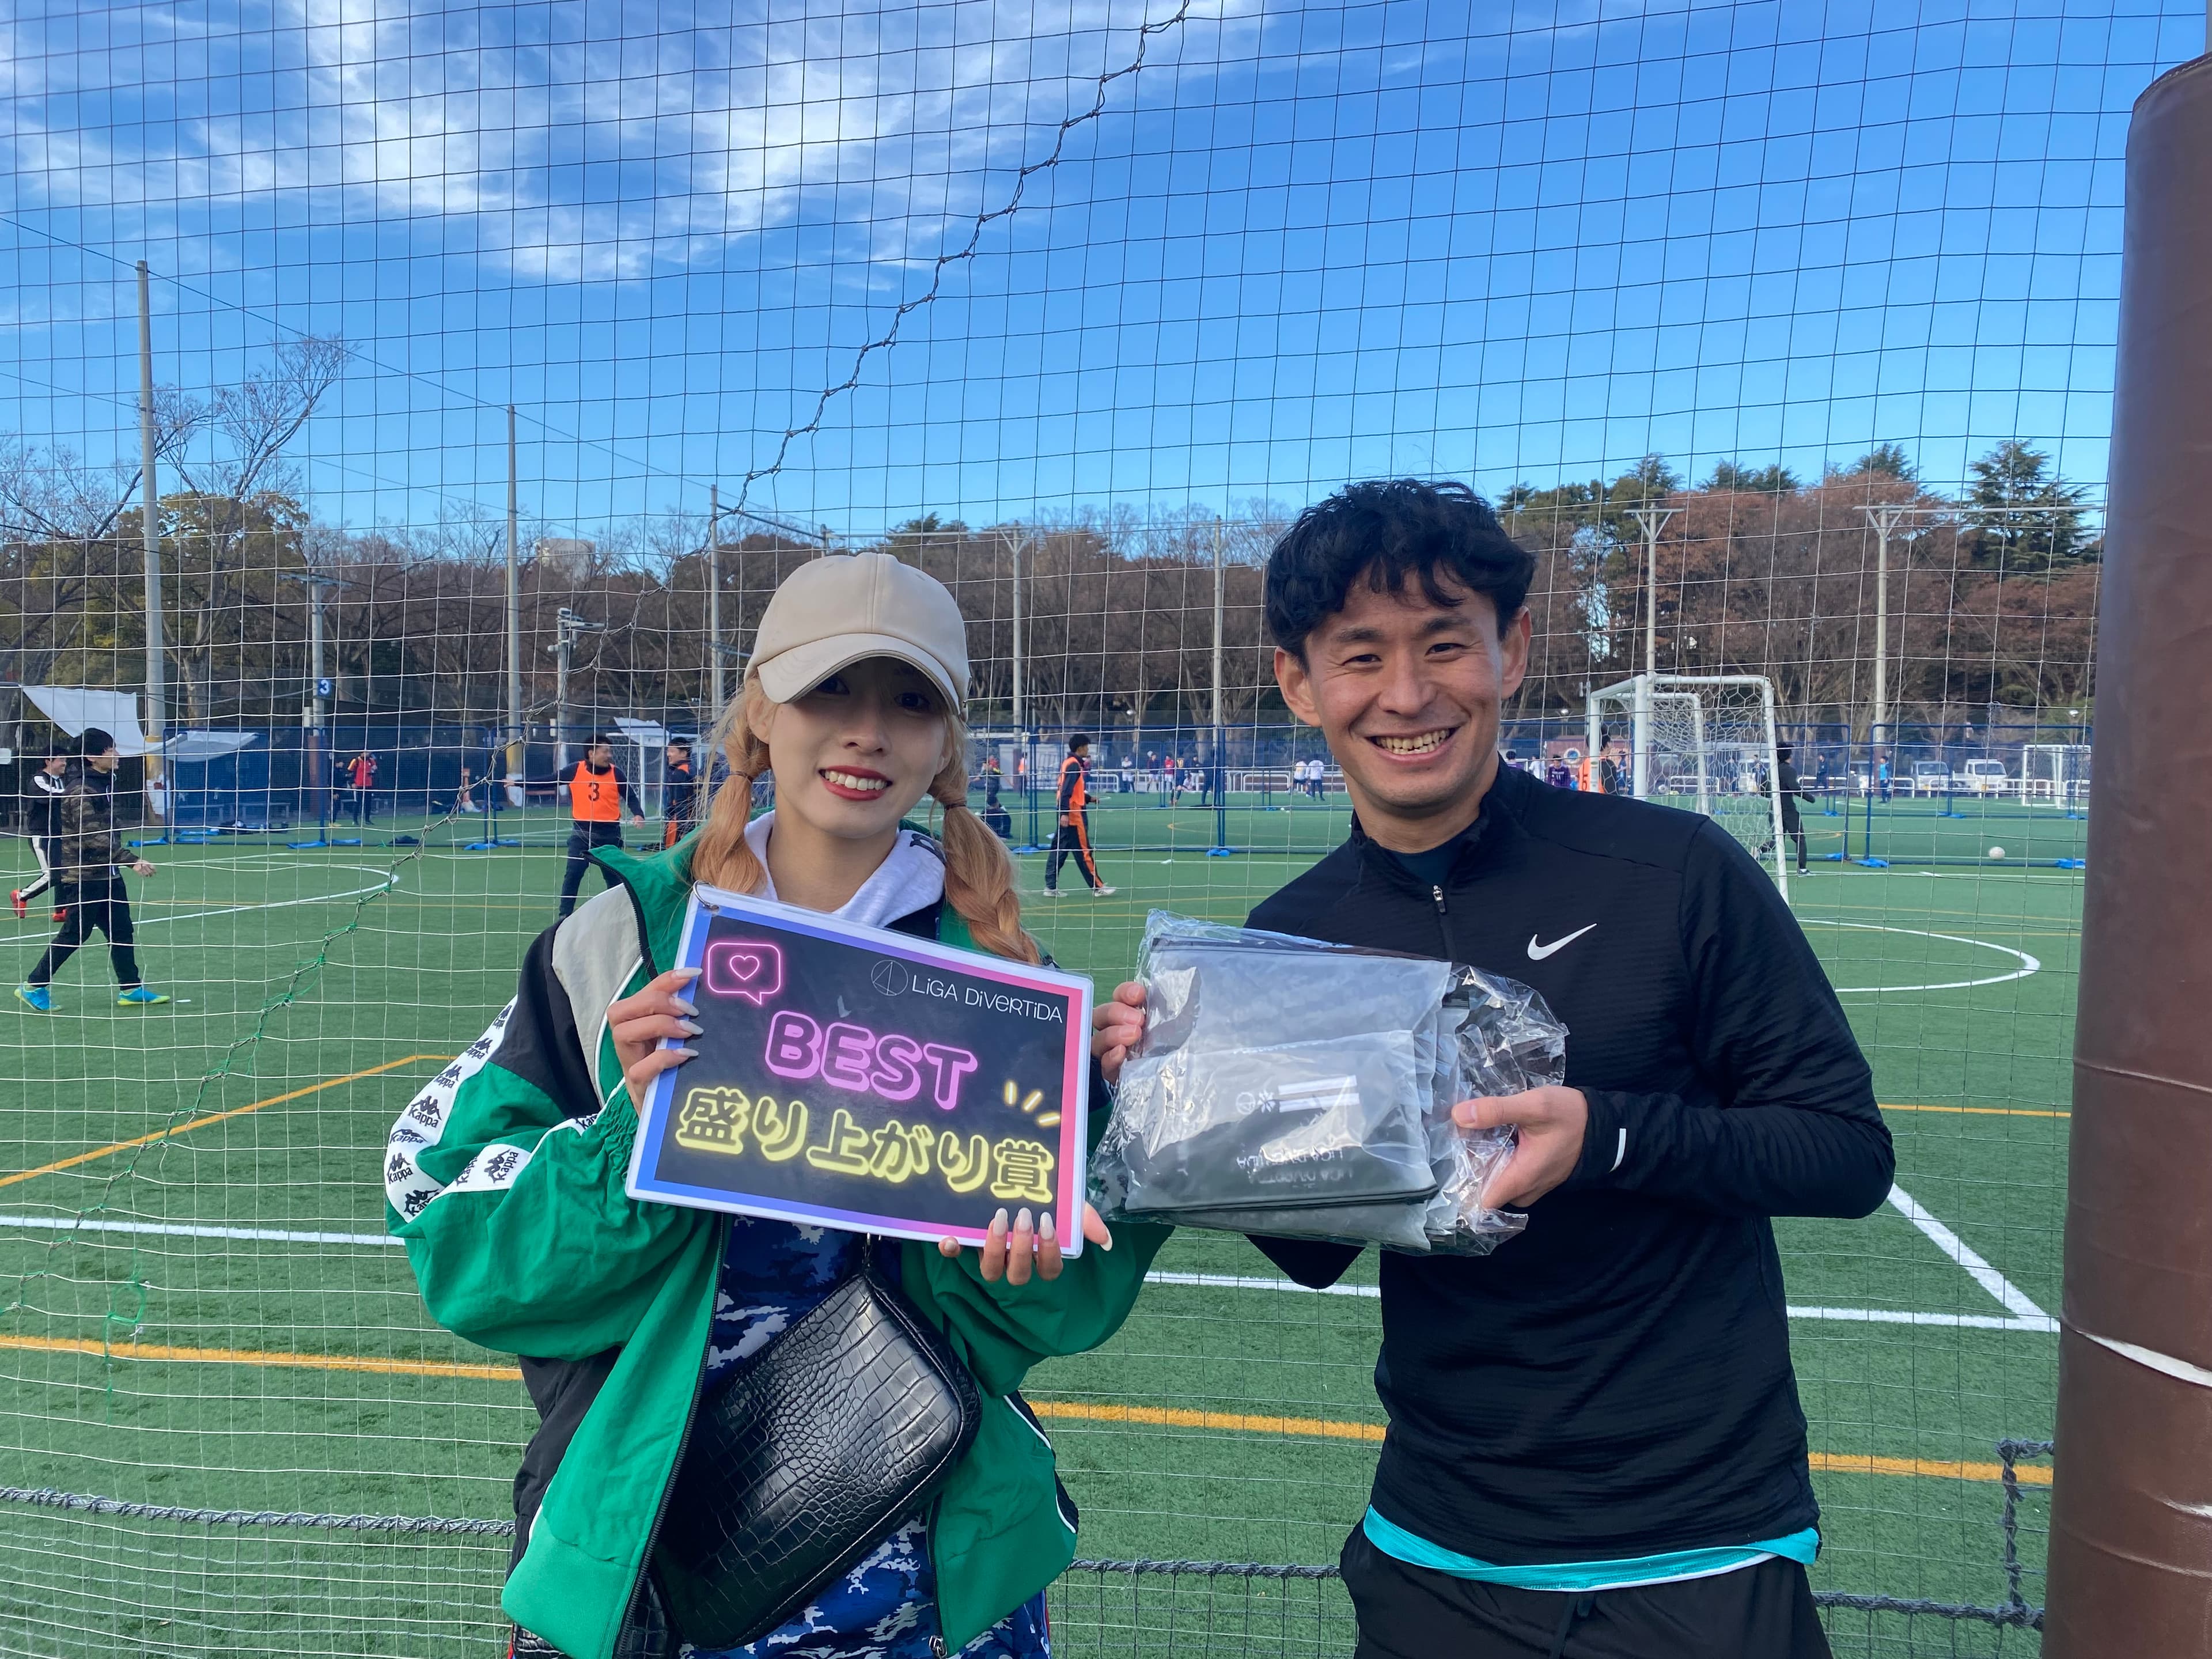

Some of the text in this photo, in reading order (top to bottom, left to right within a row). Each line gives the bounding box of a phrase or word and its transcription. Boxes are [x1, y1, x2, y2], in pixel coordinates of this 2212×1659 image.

[320, 679, 329, 694] 3
[588, 782, 600, 801] 3
[765, 1010, 978, 1110] BEST
[408, 1107, 439, 1128] Kappa
[389, 1134, 424, 1144] Kappa
[676, 1086, 1054, 1203] 盛り上がり賞
[388, 1166, 413, 1184] Kappa
[493, 1152, 519, 1183] Kappa
